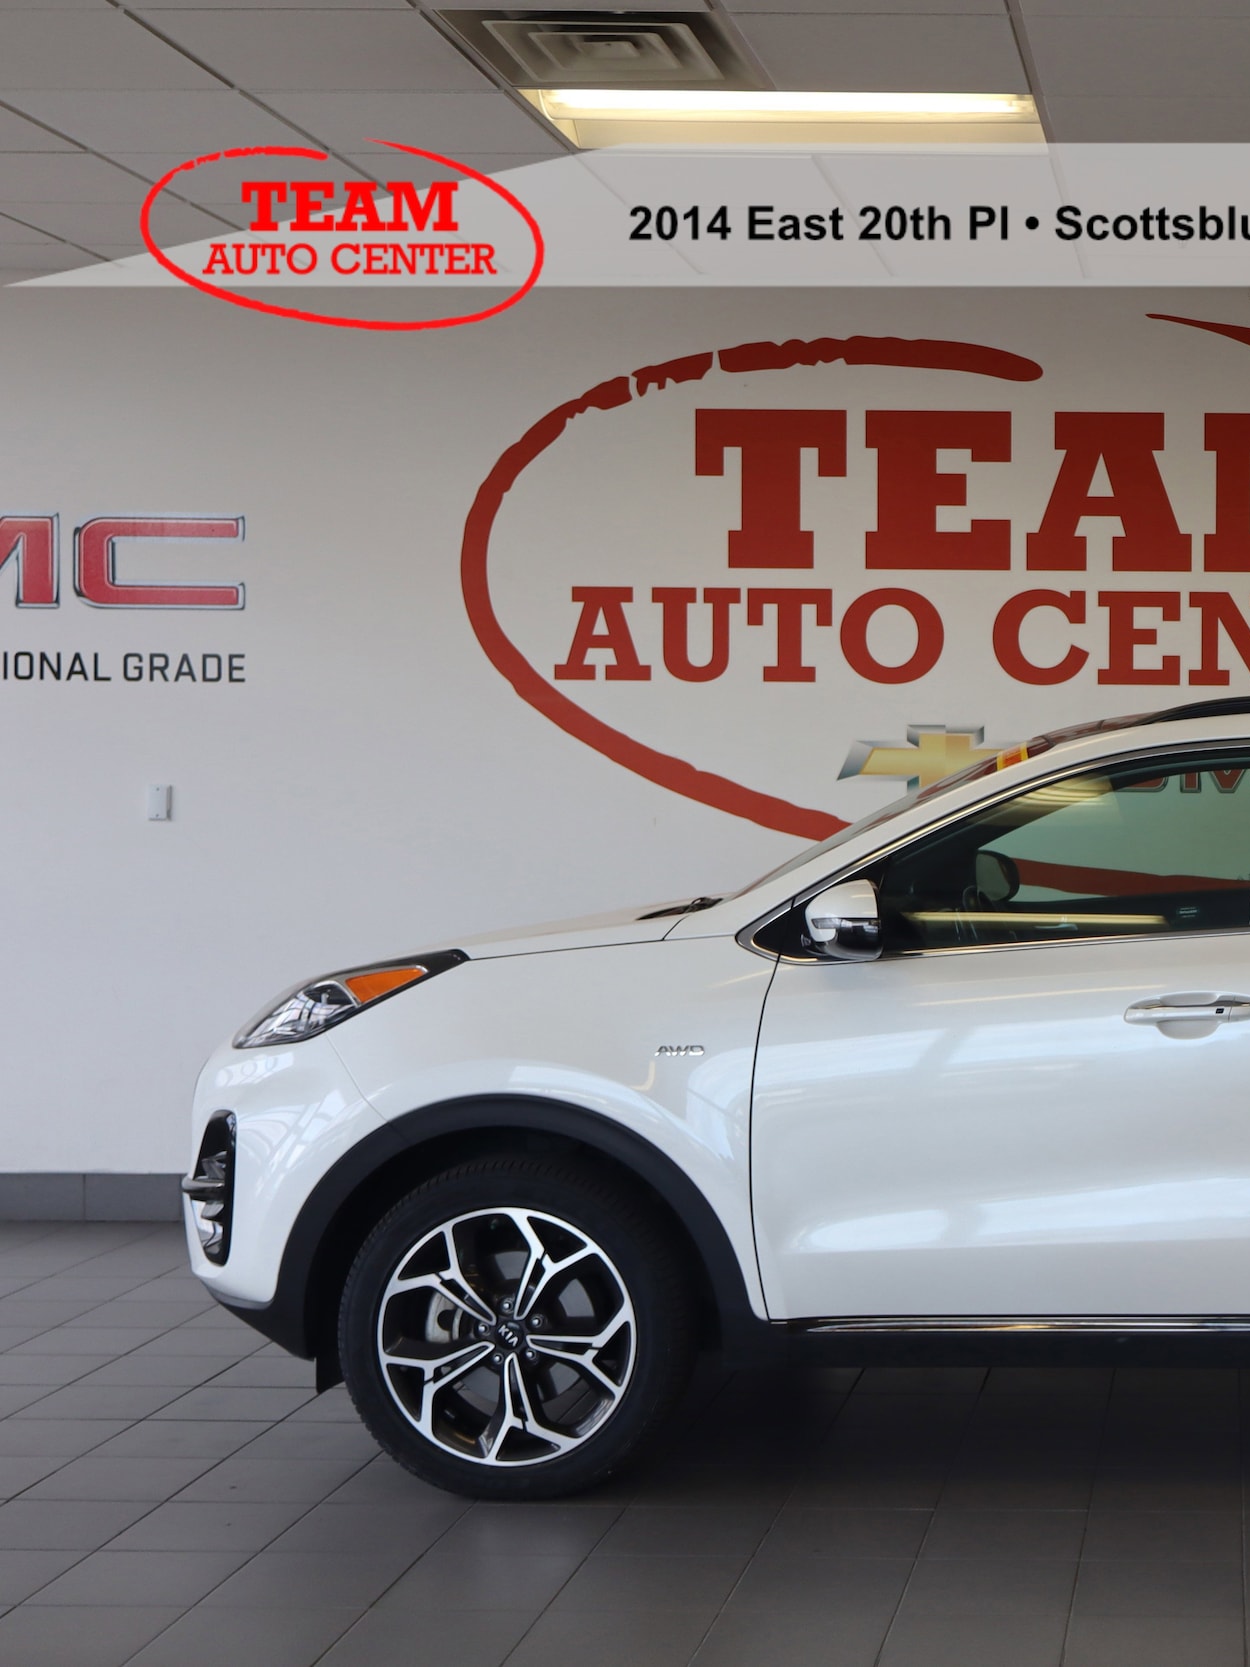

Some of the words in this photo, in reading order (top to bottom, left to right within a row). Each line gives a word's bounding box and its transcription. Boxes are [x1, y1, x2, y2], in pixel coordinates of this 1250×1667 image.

[554, 586, 945, 684] AUTO
[123, 653, 246, 683] GRADE
[654, 1045, 705, 1057] AWD
[498, 1324, 519, 1347] KIA
